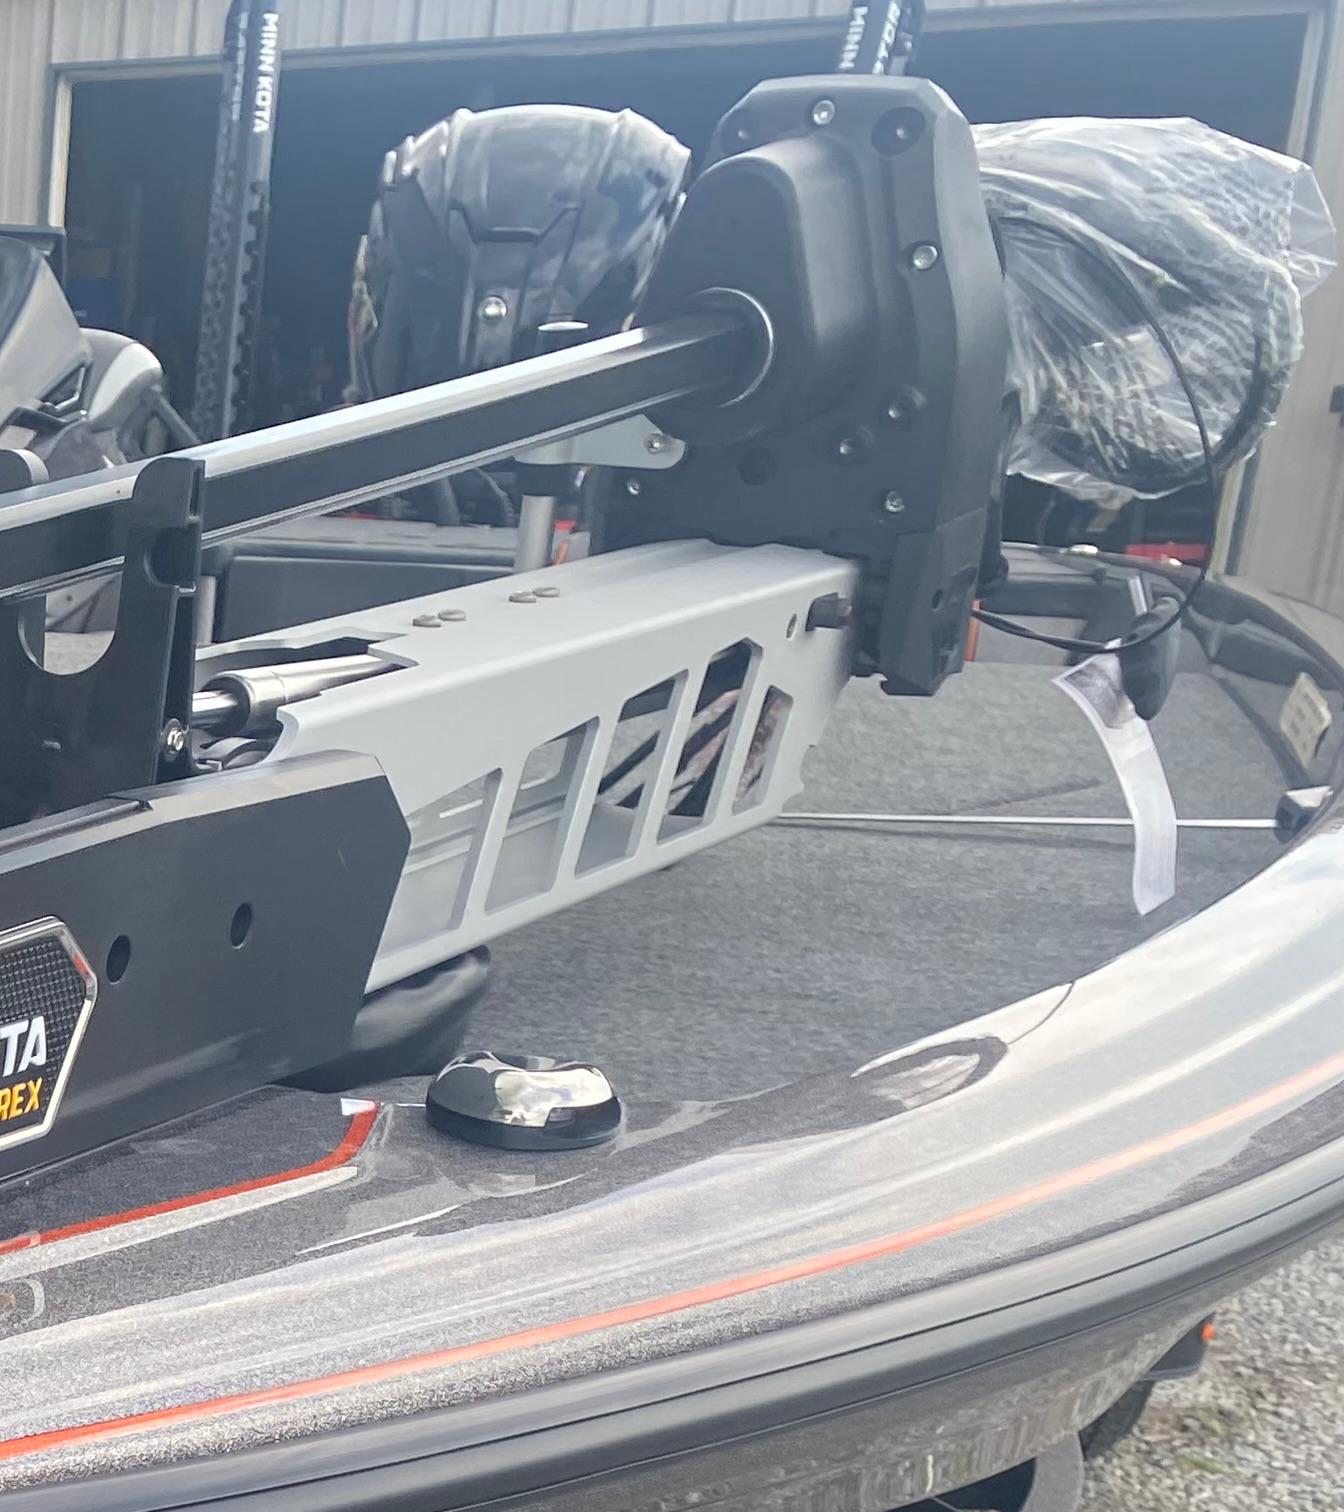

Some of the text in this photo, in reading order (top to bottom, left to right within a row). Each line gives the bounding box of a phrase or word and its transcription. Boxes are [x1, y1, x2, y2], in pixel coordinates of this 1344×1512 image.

[252, 13, 280, 133] MINN KOTA
[838, 6, 868, 69] MINN
